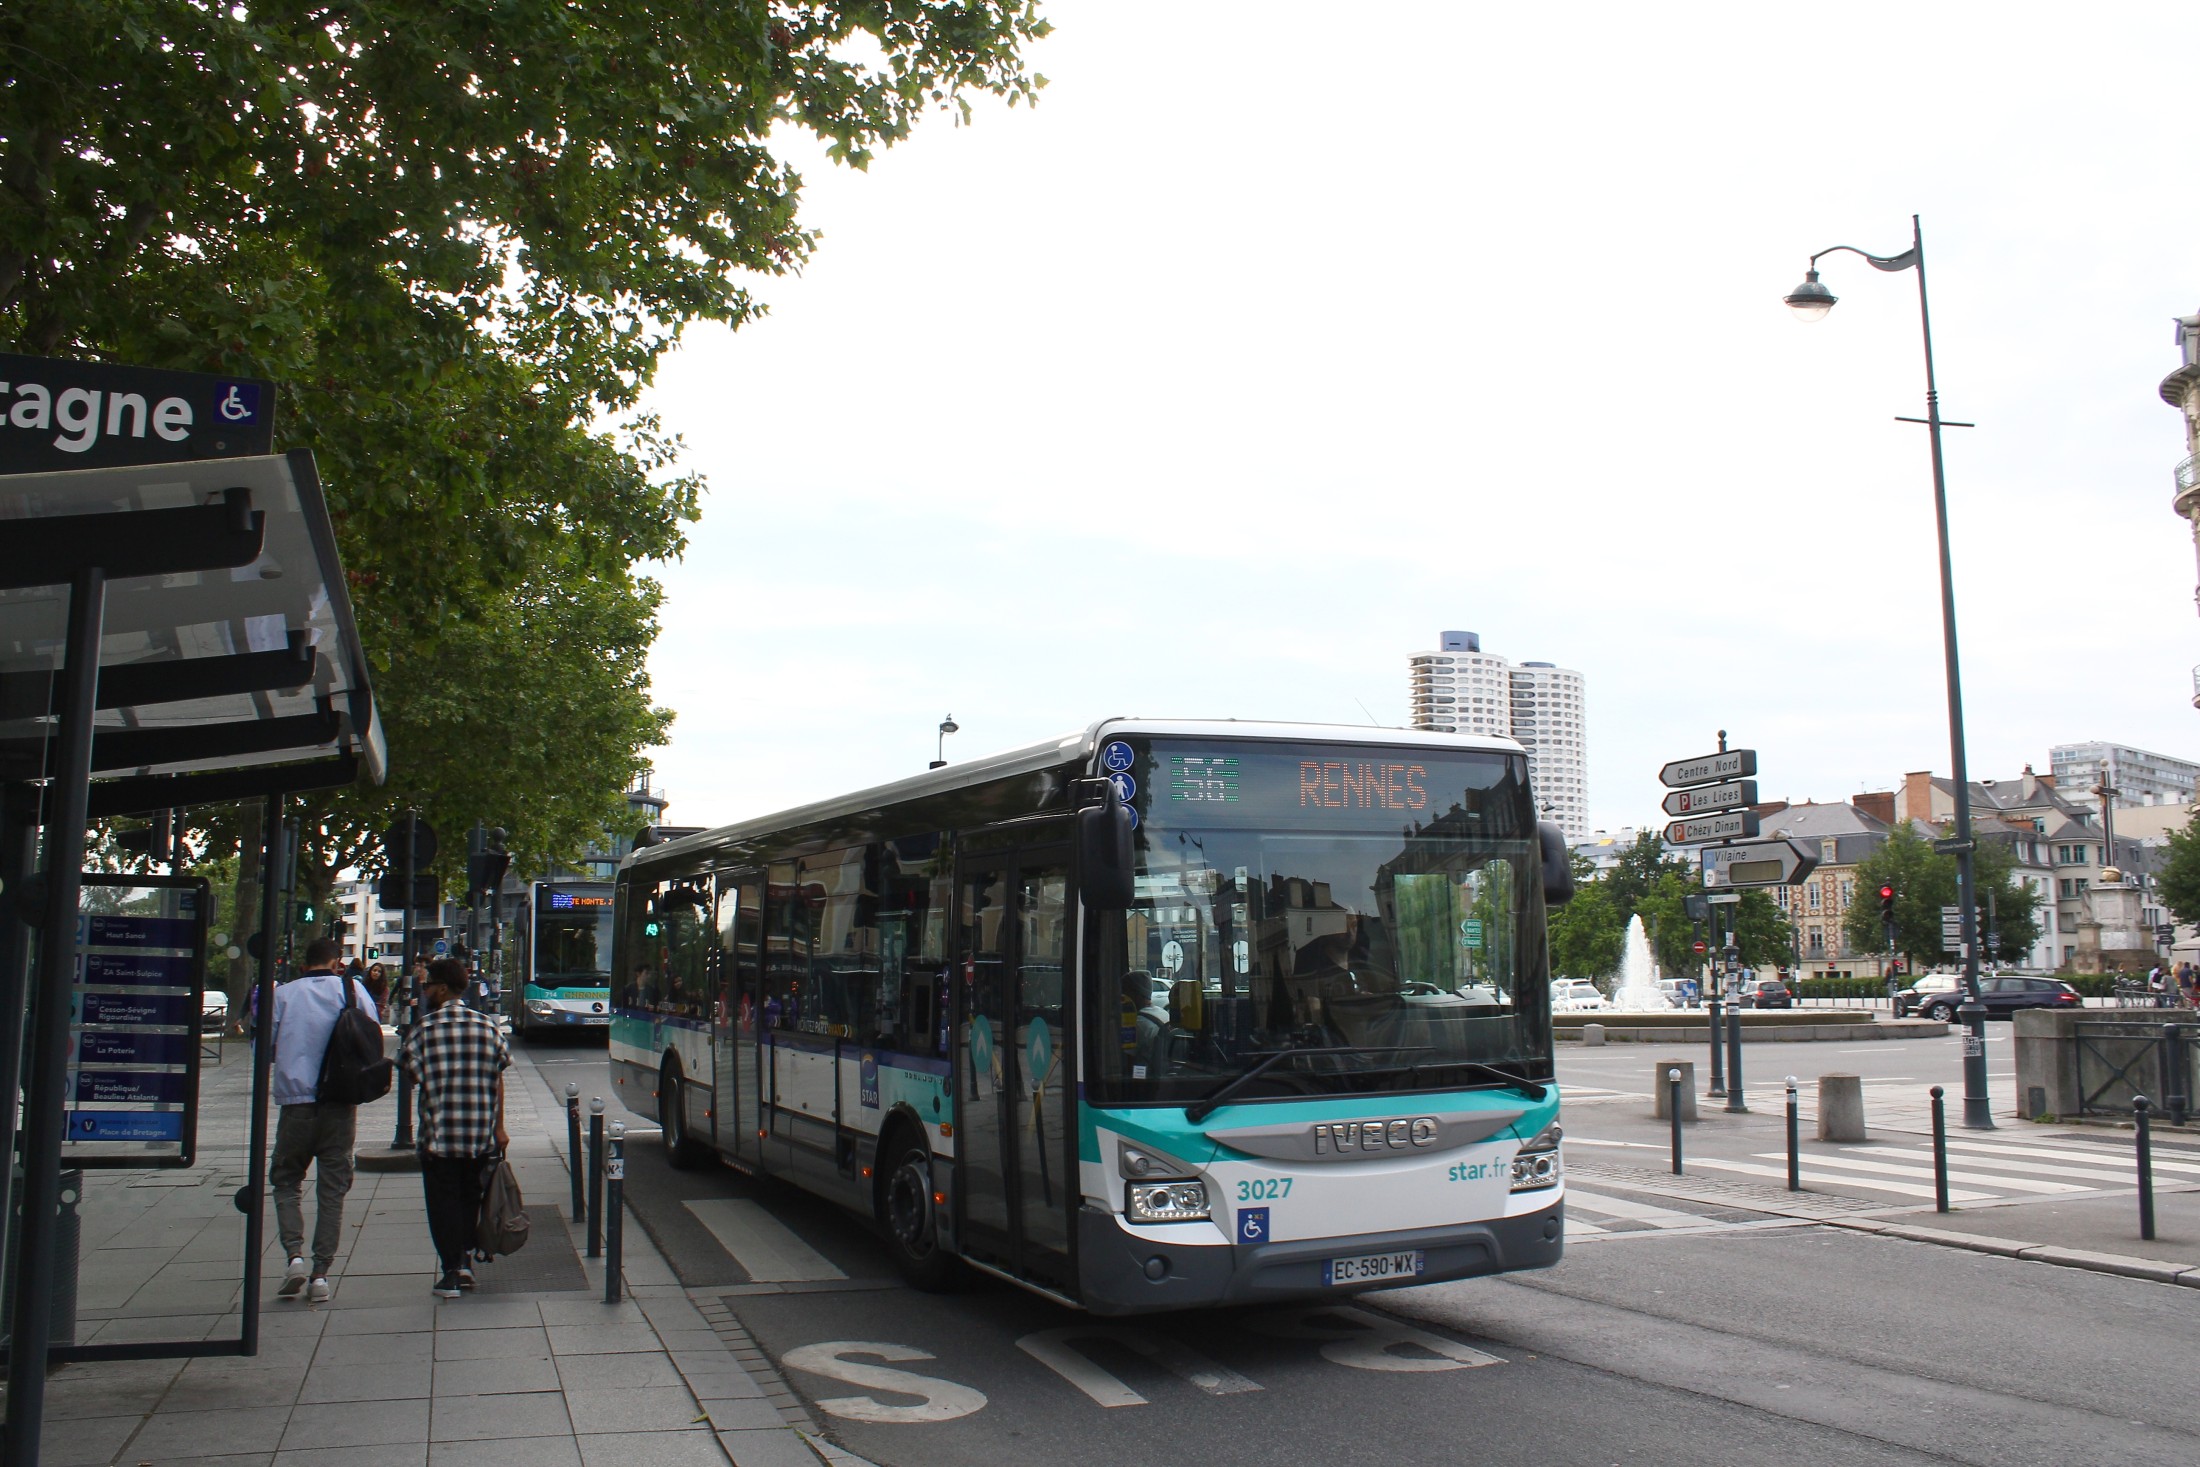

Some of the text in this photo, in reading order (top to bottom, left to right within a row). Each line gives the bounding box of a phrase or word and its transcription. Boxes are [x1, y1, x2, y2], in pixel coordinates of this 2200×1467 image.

[1677, 757, 1738, 779] Centre Nord
[1183, 757, 1427, 809] 56 RENNES
[1693, 795, 1708, 806] Les
[1713, 790, 1739, 803] Lices
[1686, 825, 1712, 838] Chézy
[1714, 820, 1740, 833] Dinan
[1714, 849, 1747, 862] Vilaine
[103, 968, 163, 978] ZA Saint-Sulpice
[98, 1006, 157, 1015] Cesson-Sévigné
[98, 1013, 142, 1022] Rigourdière
[94, 1084, 140, 1092] République/
[126, 1093, 159, 1101] Atalante
[861, 1089, 878, 1105] STAR
[99, 1128, 167, 1138] Place de Bretagne
[1315, 1117, 1438, 1156] IVECO
[1448, 1156, 1506, 1182] star.fr
[1237, 1178, 1293, 1201] 3027
[1335, 1254, 1414, 1280] EC-590-WX
